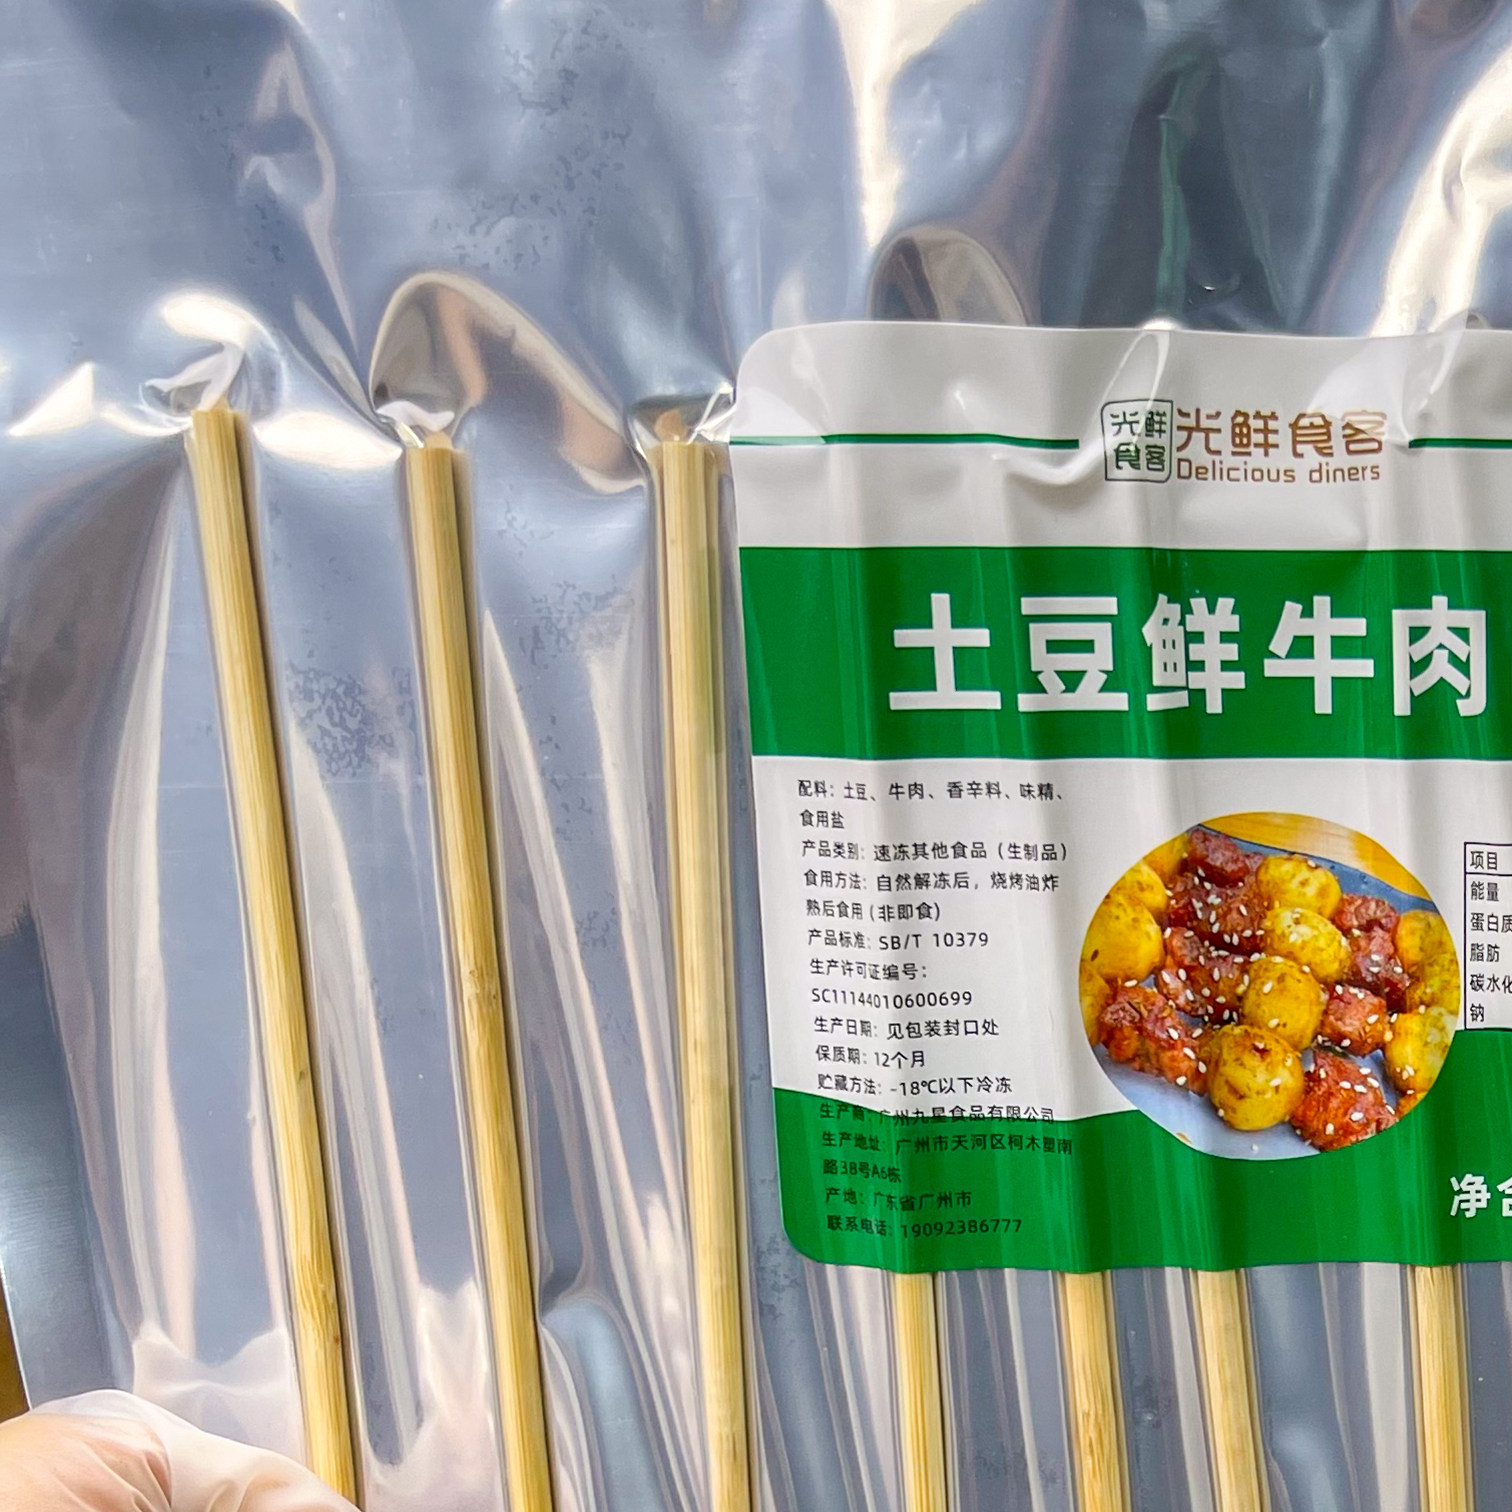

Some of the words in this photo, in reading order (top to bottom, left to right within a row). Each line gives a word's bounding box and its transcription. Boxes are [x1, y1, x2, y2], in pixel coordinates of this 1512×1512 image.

[1176, 407, 1388, 458] 光鲜食客
[1177, 458, 1296, 483] Delicious
[1308, 462, 1381, 484] diners
[800, 809, 845, 829] 食用盐
[1470, 851, 1498, 870] 项目
[1470, 881, 1500, 902] 能量
[932, 931, 989, 948] 10379
[1470, 943, 1500, 963] 脂肪
[811, 987, 973, 1009] SC11144010600699
[1470, 1003, 1486, 1022] 钠
